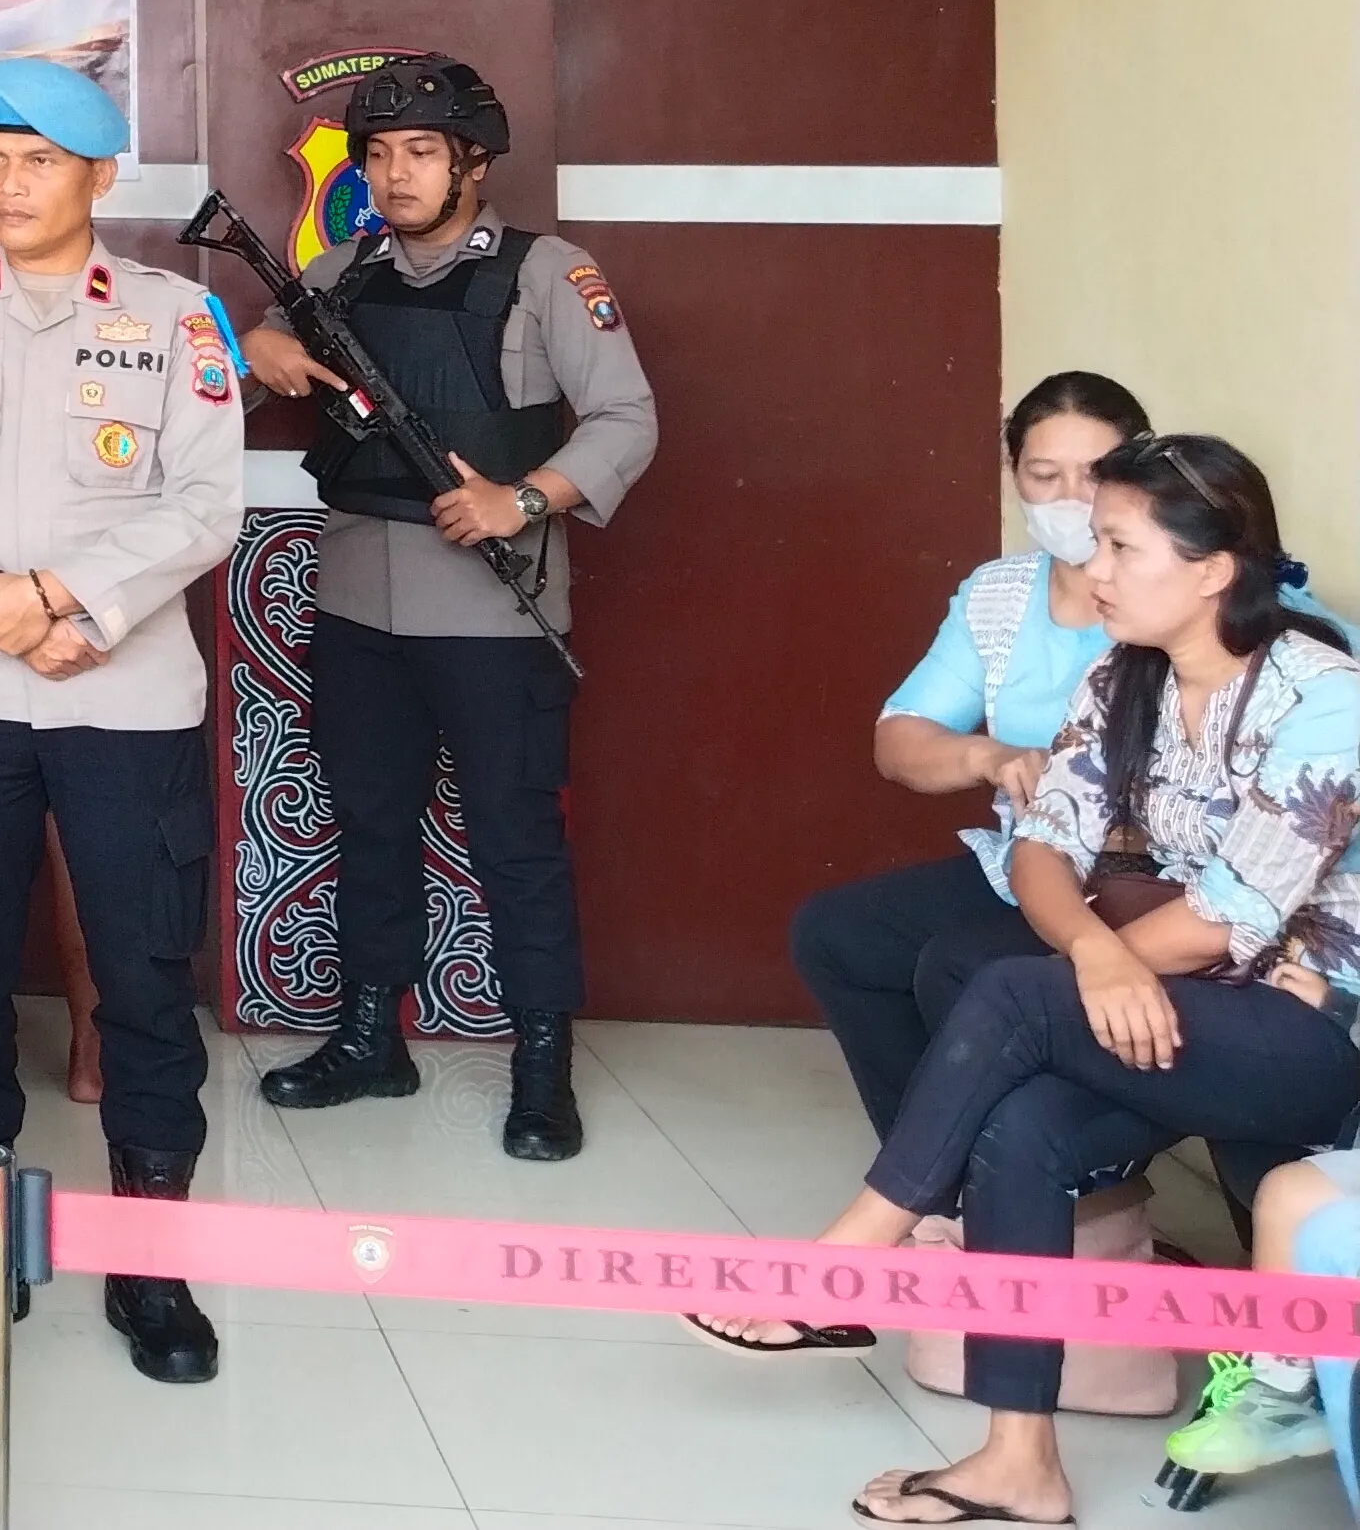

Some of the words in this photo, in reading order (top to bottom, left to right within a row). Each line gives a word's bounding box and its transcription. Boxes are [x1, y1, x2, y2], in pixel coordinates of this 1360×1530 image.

[296, 55, 385, 89] SUMATER
[75, 348, 164, 374] POLRI
[499, 1242, 1038, 1315] DIREKTORAT
